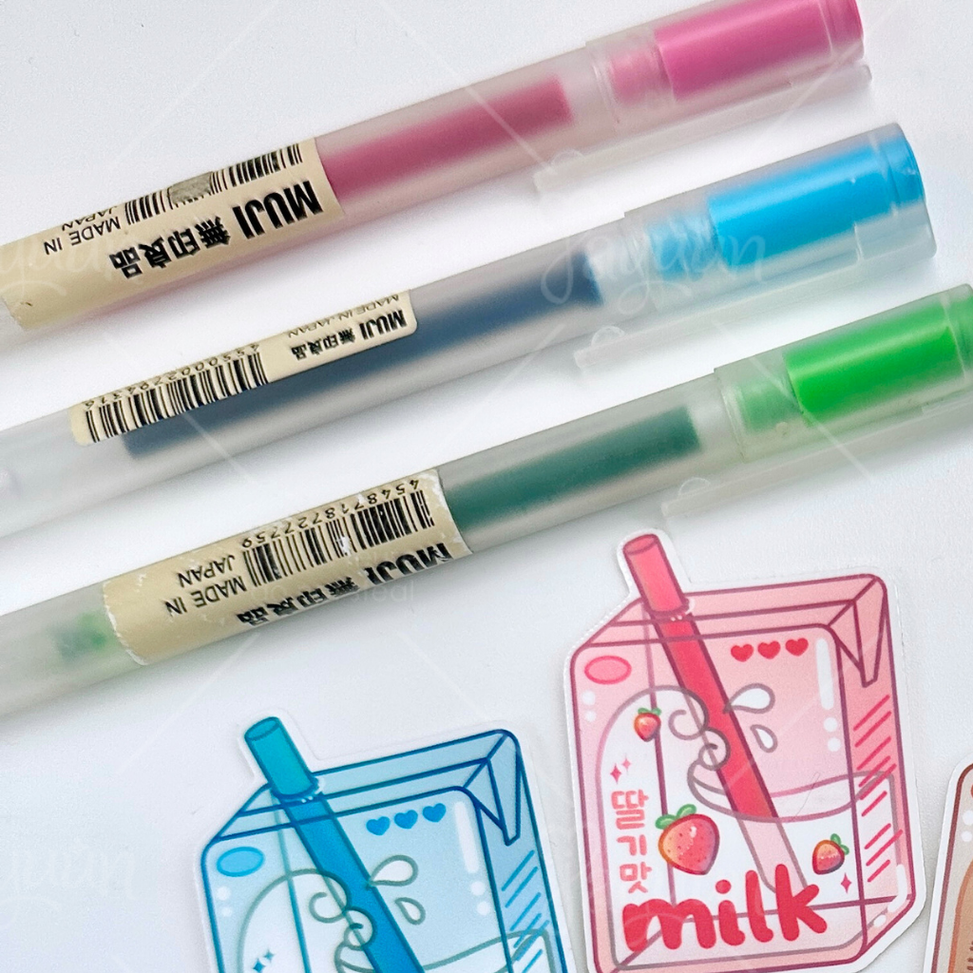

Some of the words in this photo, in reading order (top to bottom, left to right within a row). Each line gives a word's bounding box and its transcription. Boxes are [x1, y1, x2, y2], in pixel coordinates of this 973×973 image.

[232, 180, 323, 240] MUJI
[43, 237, 62, 255] IN
[70, 216, 121, 246] MADE
[109, 215, 231, 279] 無印良品
[355, 293, 399, 315] MADE
[288, 316, 336, 338] JAPAN
[359, 309, 407, 341] MUJI
[290, 327, 356, 361] 無印良品
[242, 479, 420, 549] 4548718727759
[178, 554, 236, 588] JAPAN
[364, 542, 453, 585] MUJI
[165, 596, 188, 616] IN
[194, 575, 247, 608] MADE
[610, 787, 653, 895] 딸기맛
[622, 863, 828, 953] milk
